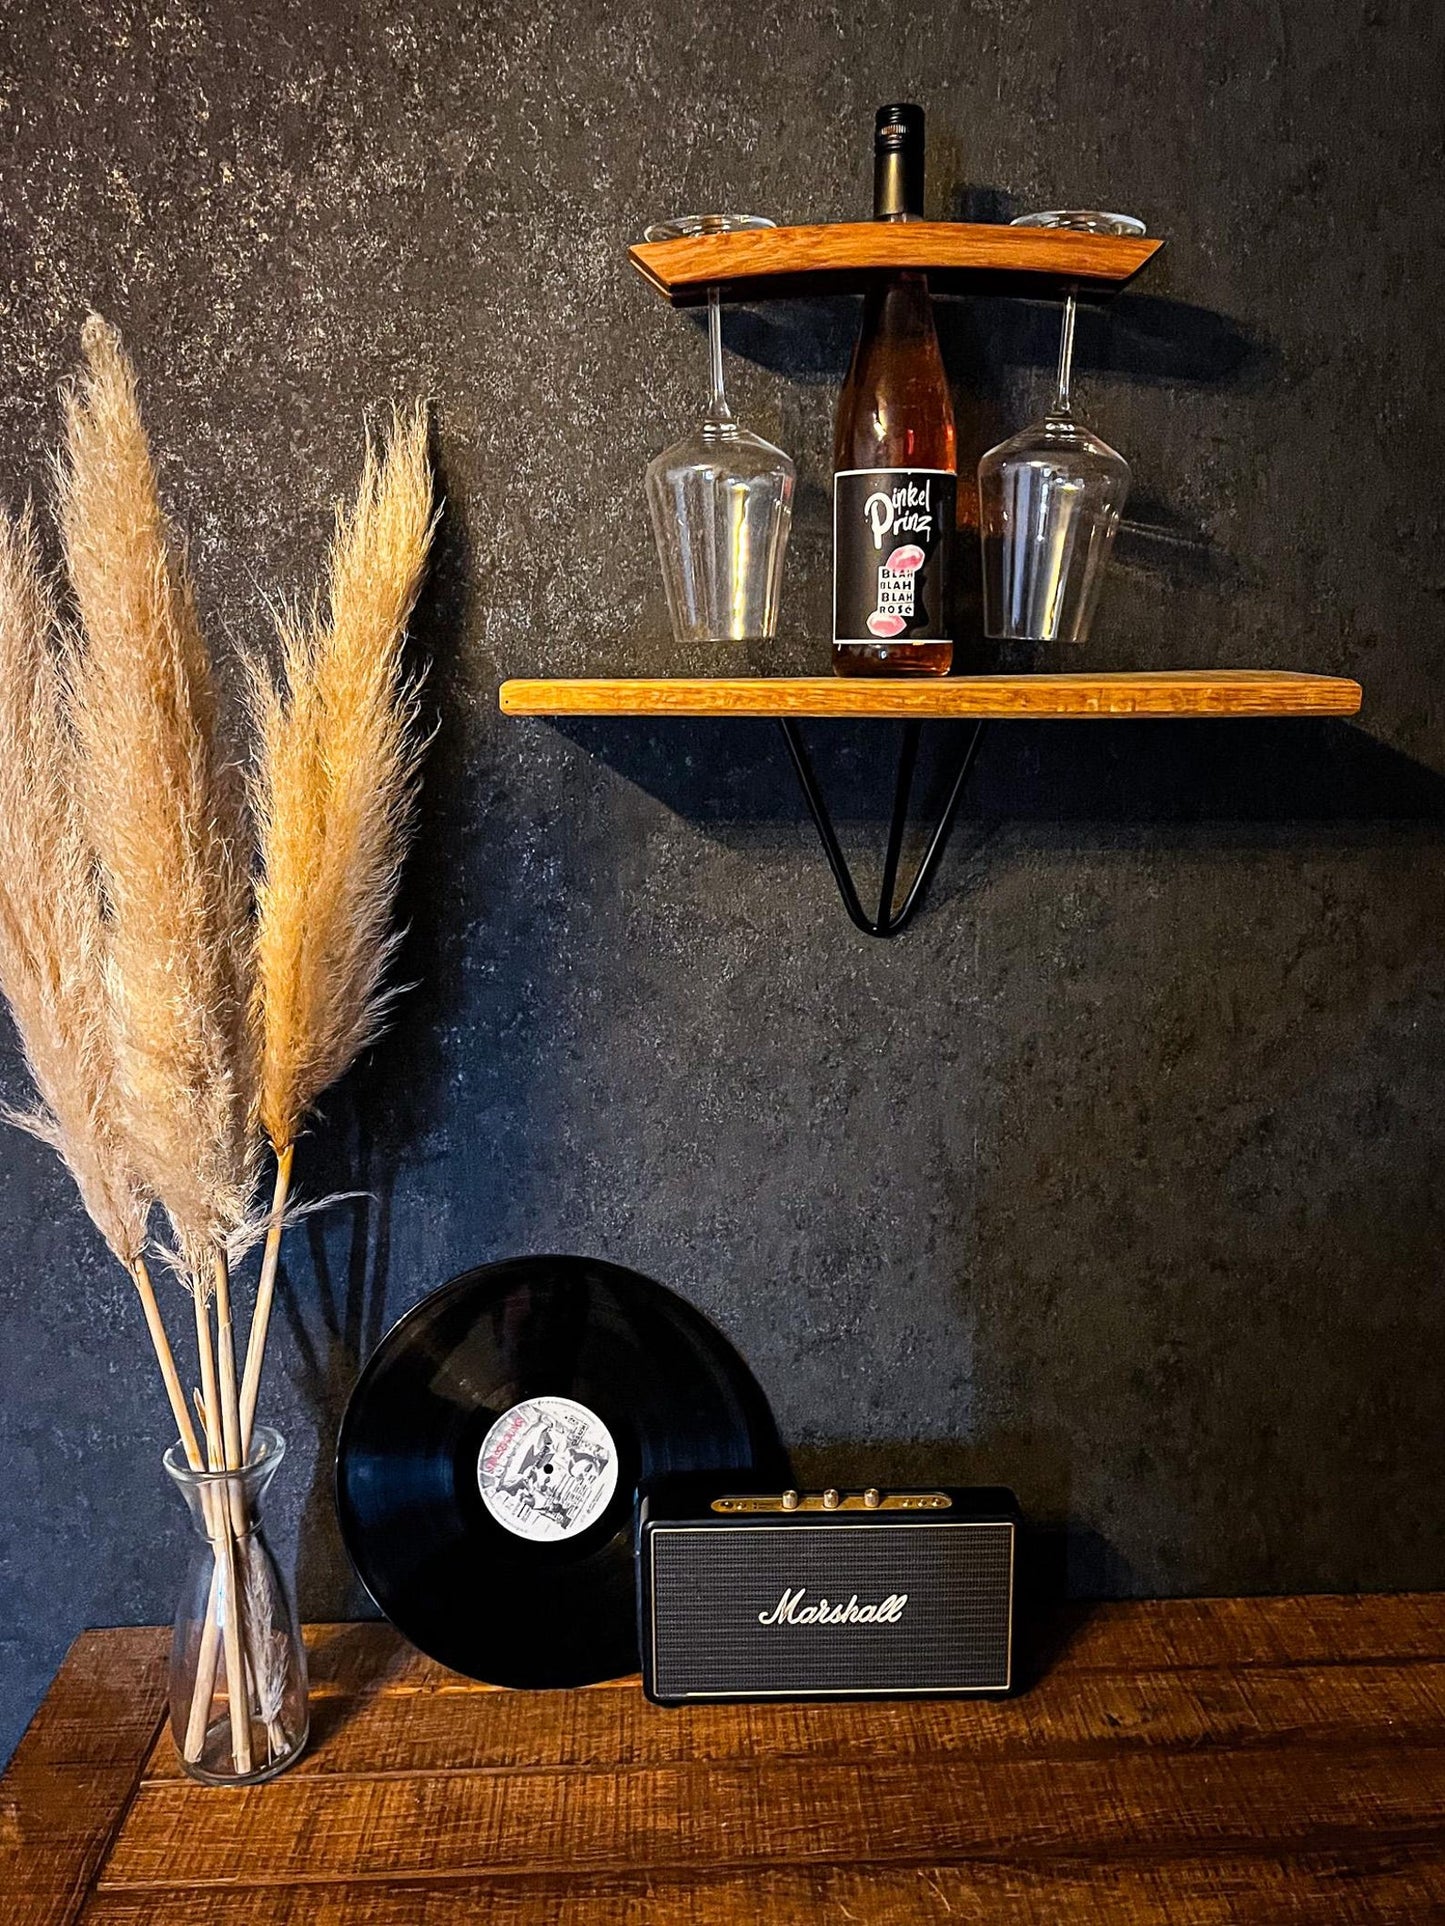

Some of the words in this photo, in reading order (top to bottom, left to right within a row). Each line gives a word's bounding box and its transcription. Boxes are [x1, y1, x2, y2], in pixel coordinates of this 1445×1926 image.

[881, 568, 913, 579] BLAH
[880, 581, 912, 590] BLAH
[881, 592, 913, 602] BLAH
[758, 1587, 909, 1625] Marshall
